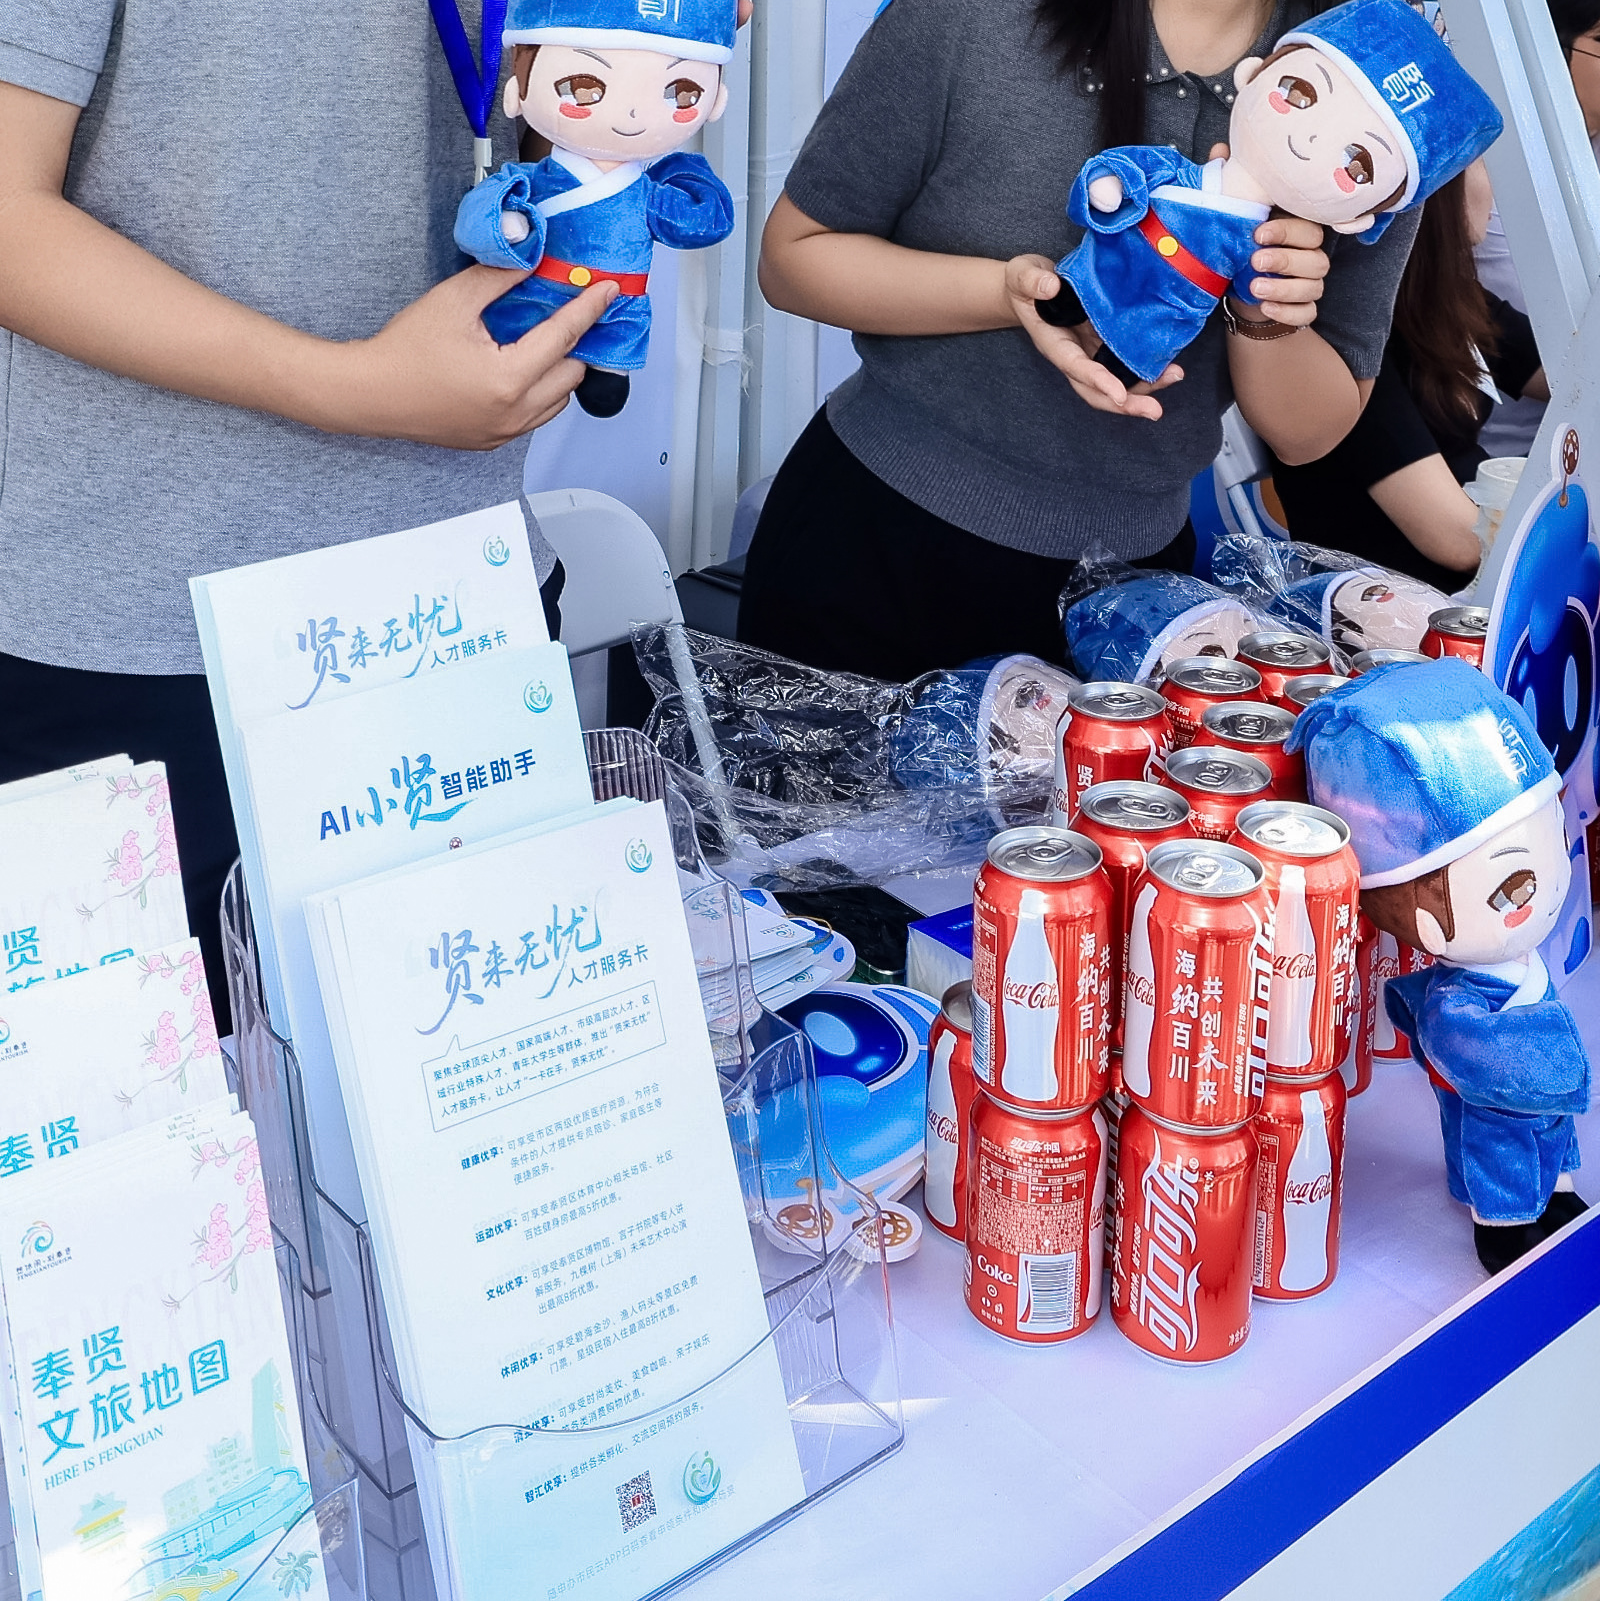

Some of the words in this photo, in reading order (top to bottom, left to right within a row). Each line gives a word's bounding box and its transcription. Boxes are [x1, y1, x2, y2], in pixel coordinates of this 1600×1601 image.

[286, 579, 463, 710] 贤来无忧
[430, 630, 508, 669] 人才服务卡
[415, 887, 605, 1036] 贤来无忧
[568, 944, 649, 988] 人才服务卡
[1332, 904, 1350, 1027] 海纳百川
[1071, 933, 1100, 1065] 海纳百川
[1164, 949, 1200, 1083] 海纳百川
[1191, 976, 1228, 1106] 共创未来
[461, 1146, 504, 1171] 健康优享：
[513, 1163, 555, 1186] 便捷服务。
[1203, 1170, 1215, 1193] 汽水
[475, 1217, 518, 1244] 运动优享：
[1139, 1127, 1203, 1354] 可口可乐
[485, 1275, 528, 1302] 文化优享：
[31, 1325, 127, 1400] 奉贤
[500, 1351, 544, 1380] 休闲优享：
[37, 1339, 230, 1467] 文旅地图
[44, 1463, 80, 1491] HERE
[83, 1456, 96, 1473] IS
[98, 1424, 165, 1464] FENGXIAN
[524, 1472, 568, 1504] 智汇优享：
